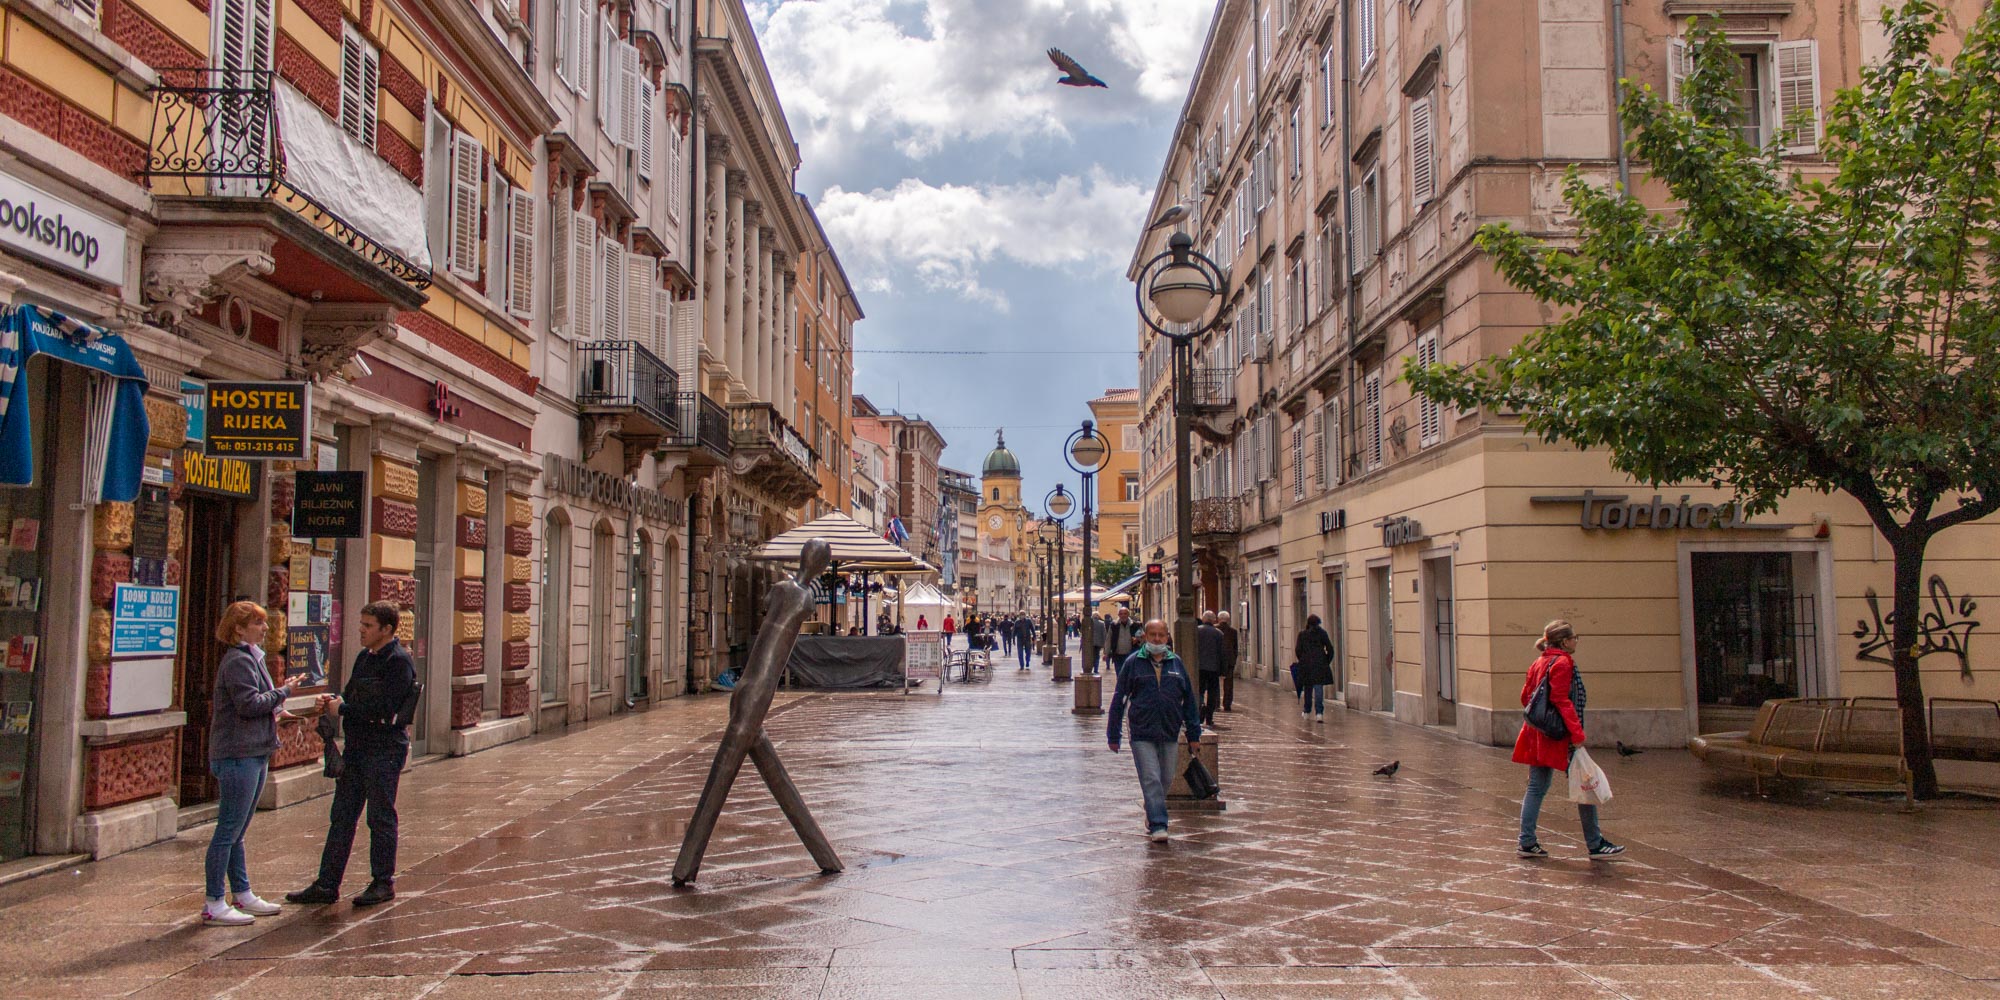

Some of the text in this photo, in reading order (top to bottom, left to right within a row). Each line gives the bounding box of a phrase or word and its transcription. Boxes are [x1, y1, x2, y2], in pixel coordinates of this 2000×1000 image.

[211, 390, 300, 410] HOSTEL
[223, 414, 287, 430] RIJEKA
[215, 441, 295, 452] Tel: 051-215 415
[183, 448, 220, 489] HOSTEL
[220, 458, 251, 495] RIJEKA
[312, 482, 344, 493] JAVNI
[543, 452, 594, 499] UNITED
[596, 470, 635, 512] COLORS
[300, 497, 355, 509] BILJEŽNIK
[307, 516, 346, 526] NOTAR
[122, 588, 174, 605] ROOMS KORZO
